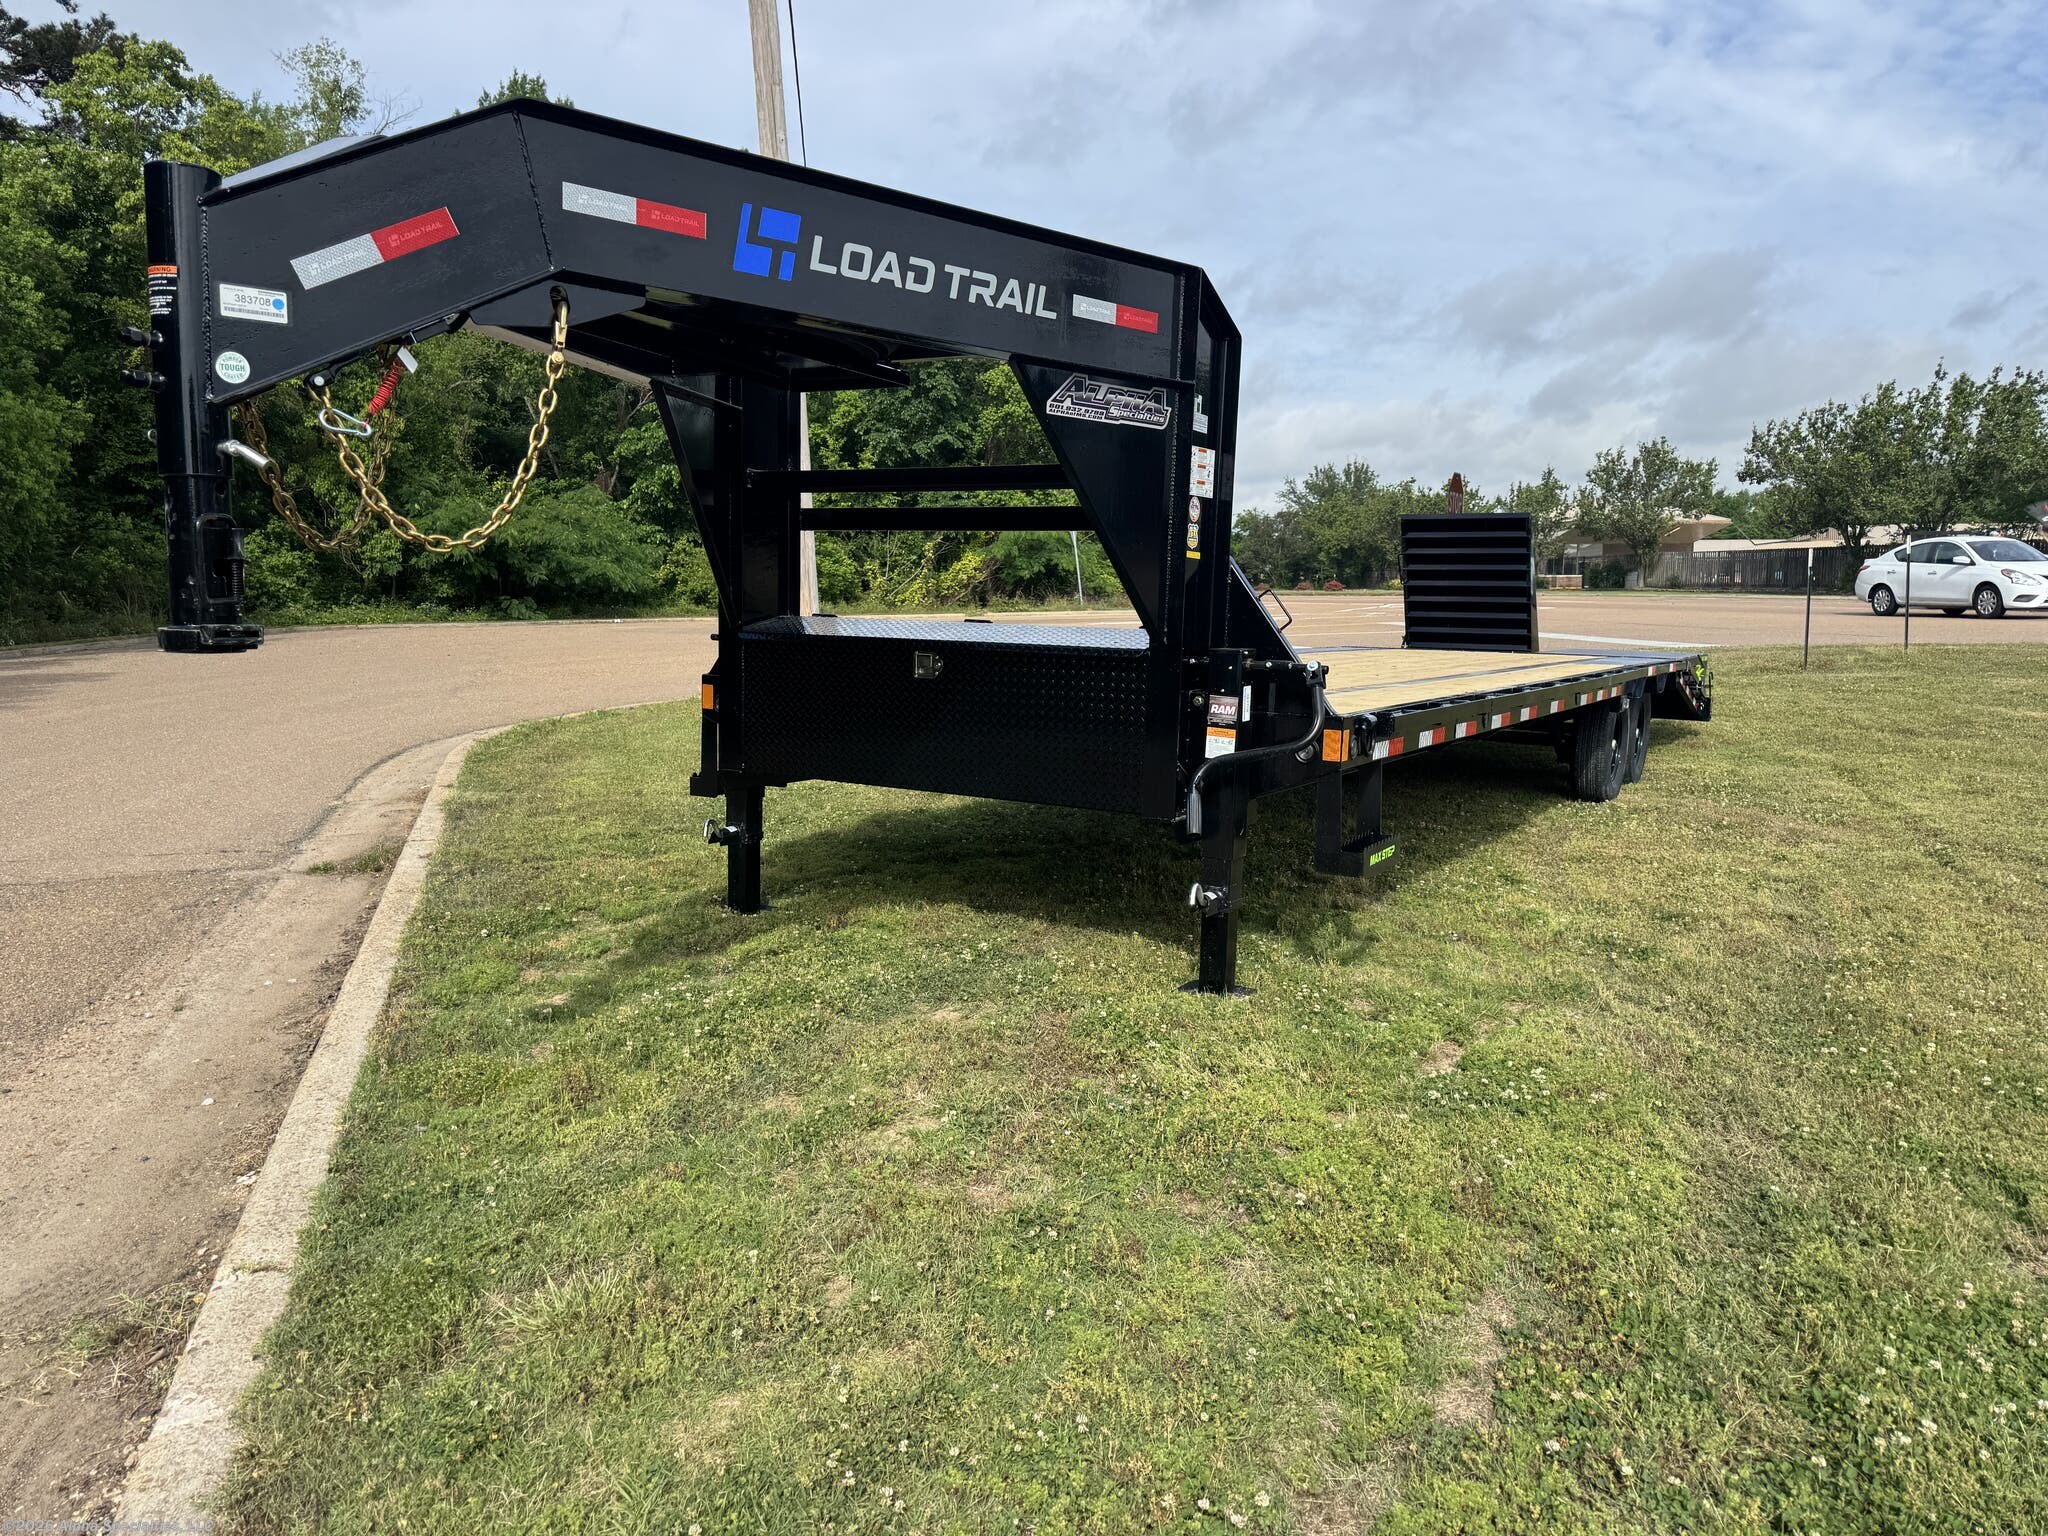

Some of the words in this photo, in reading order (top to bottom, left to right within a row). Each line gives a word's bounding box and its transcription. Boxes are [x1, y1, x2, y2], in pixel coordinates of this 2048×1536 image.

[810, 235, 936, 294] LOAD
[944, 264, 1057, 320] TRAIL
[234, 293, 271, 307] 383708
[221, 363, 245, 372] TOUGH
[1108, 406, 1165, 423] Specialties
[1210, 704, 1236, 716] RAM
